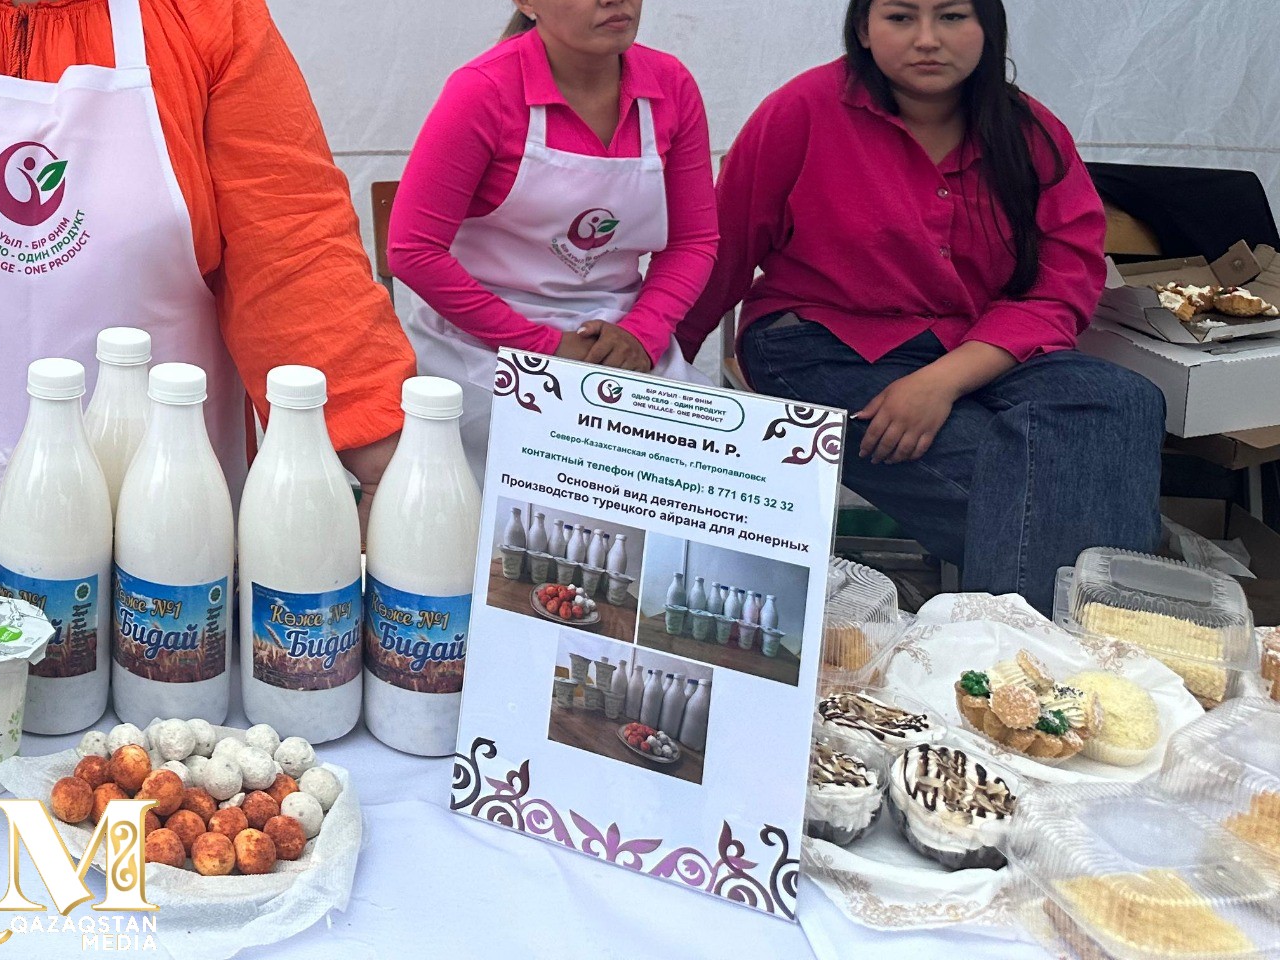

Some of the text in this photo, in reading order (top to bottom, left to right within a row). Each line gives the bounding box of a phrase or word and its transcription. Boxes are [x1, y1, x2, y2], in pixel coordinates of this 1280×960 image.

[18, 250, 50, 264] ОДИН
[50, 209, 85, 255] ПРОДУКТ
[24, 263, 47, 275] ONE
[48, 230, 91, 270] PRODUCT
[31, 238, 46, 250] БІР
[49, 217, 70, 242] ӨНІМ
[631, 393, 650, 401] ОДНО
[651, 396, 669, 405] СЕЛО
[674, 401, 694, 410] ОДИН
[695, 405, 726, 416] ПРОДУКТ
[632, 401, 646, 409] ONE
[692, 412, 723, 423] PRODUCT
[658, 390, 677, 399] АУЫЛ
[550, 430, 646, 457] Северо-Казахстанская
[648, 453, 687, 467] область,
[578, 413, 741, 458] ИП Моминова И. Р.
[521, 446, 794, 512] контактный телефон (WhatsApp): 8 771 615 32 32
[557, 472, 748, 524] Основной вид деятельности:
[501, 473, 809, 553] Производство турецкого айрана для донерных
[270, 604, 324, 626] Көже
[371, 593, 413, 625] Көже
[120, 606, 199, 660] Бидай
[379, 621, 466, 672] Бидай
